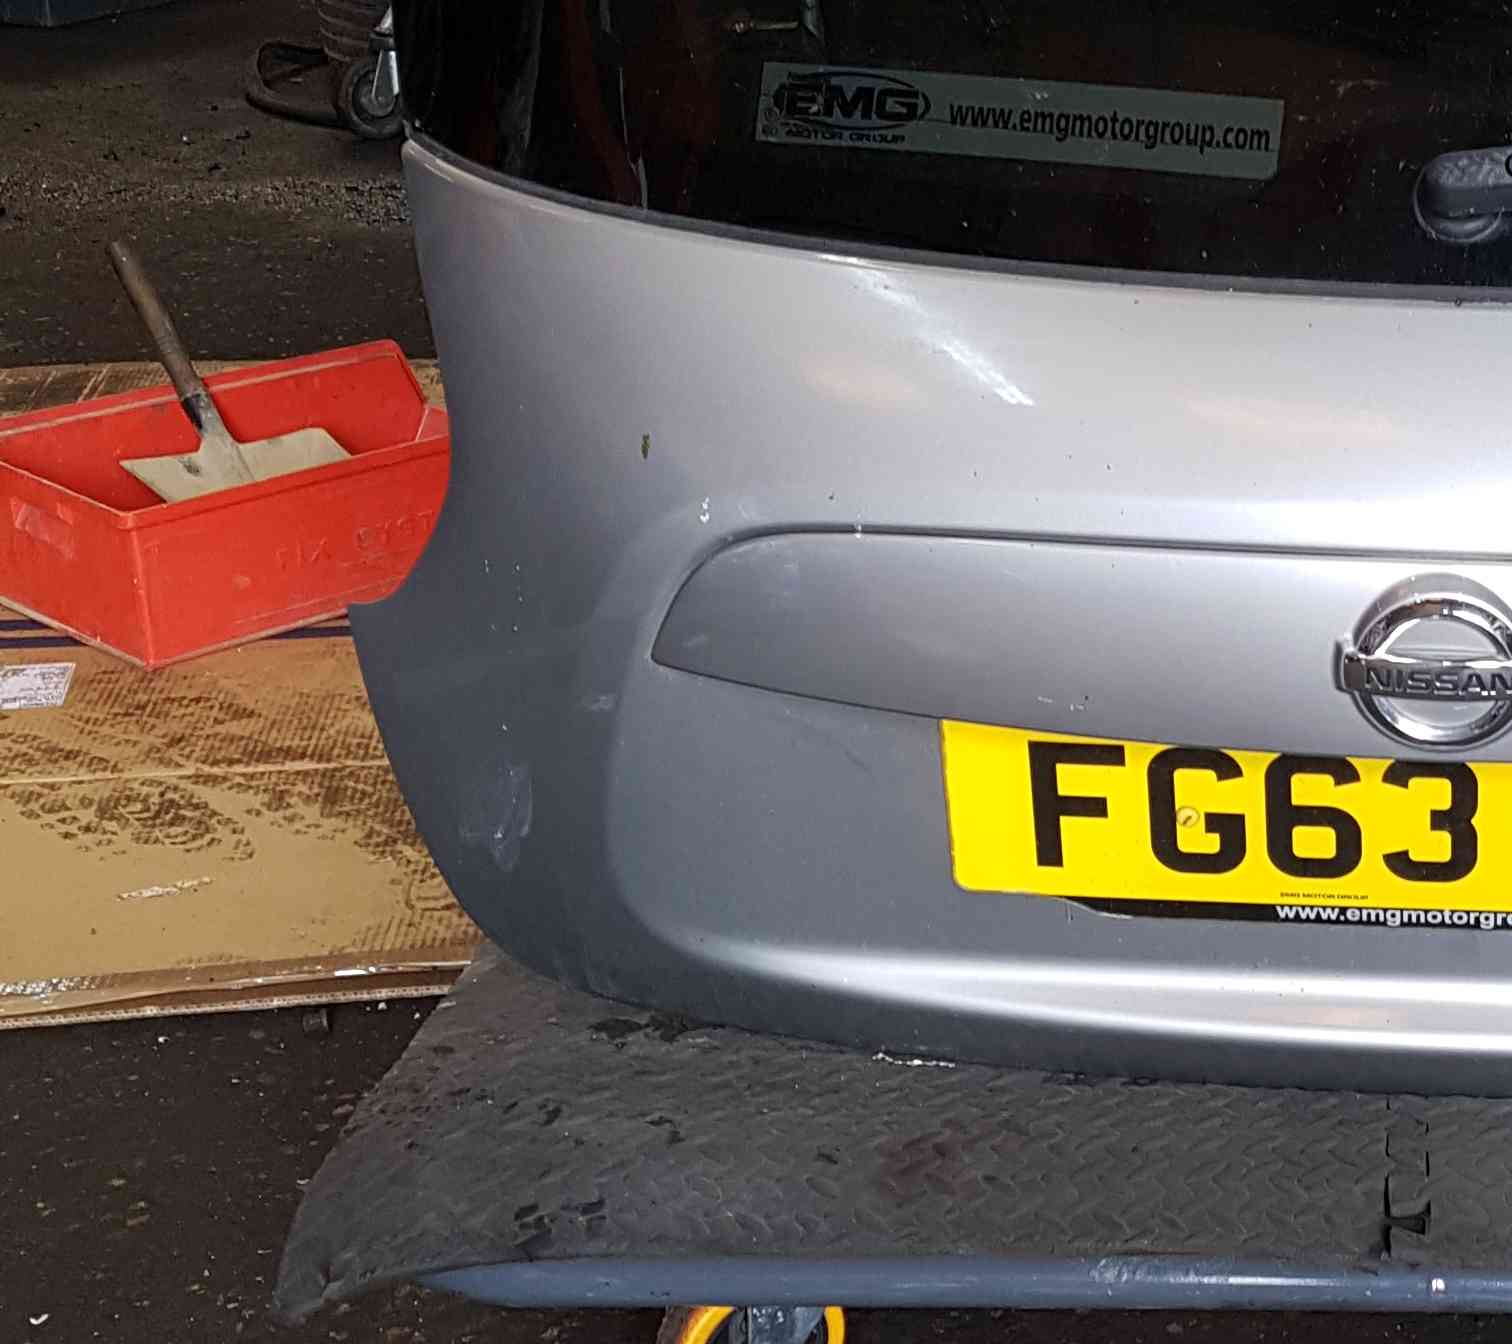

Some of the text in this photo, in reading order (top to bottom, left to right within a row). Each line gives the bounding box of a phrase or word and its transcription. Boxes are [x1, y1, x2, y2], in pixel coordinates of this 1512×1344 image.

[786, 79, 920, 122] EMG
[949, 102, 1271, 155] www.emgmotorgroup.com
[1028, 740, 1479, 884] FG63
